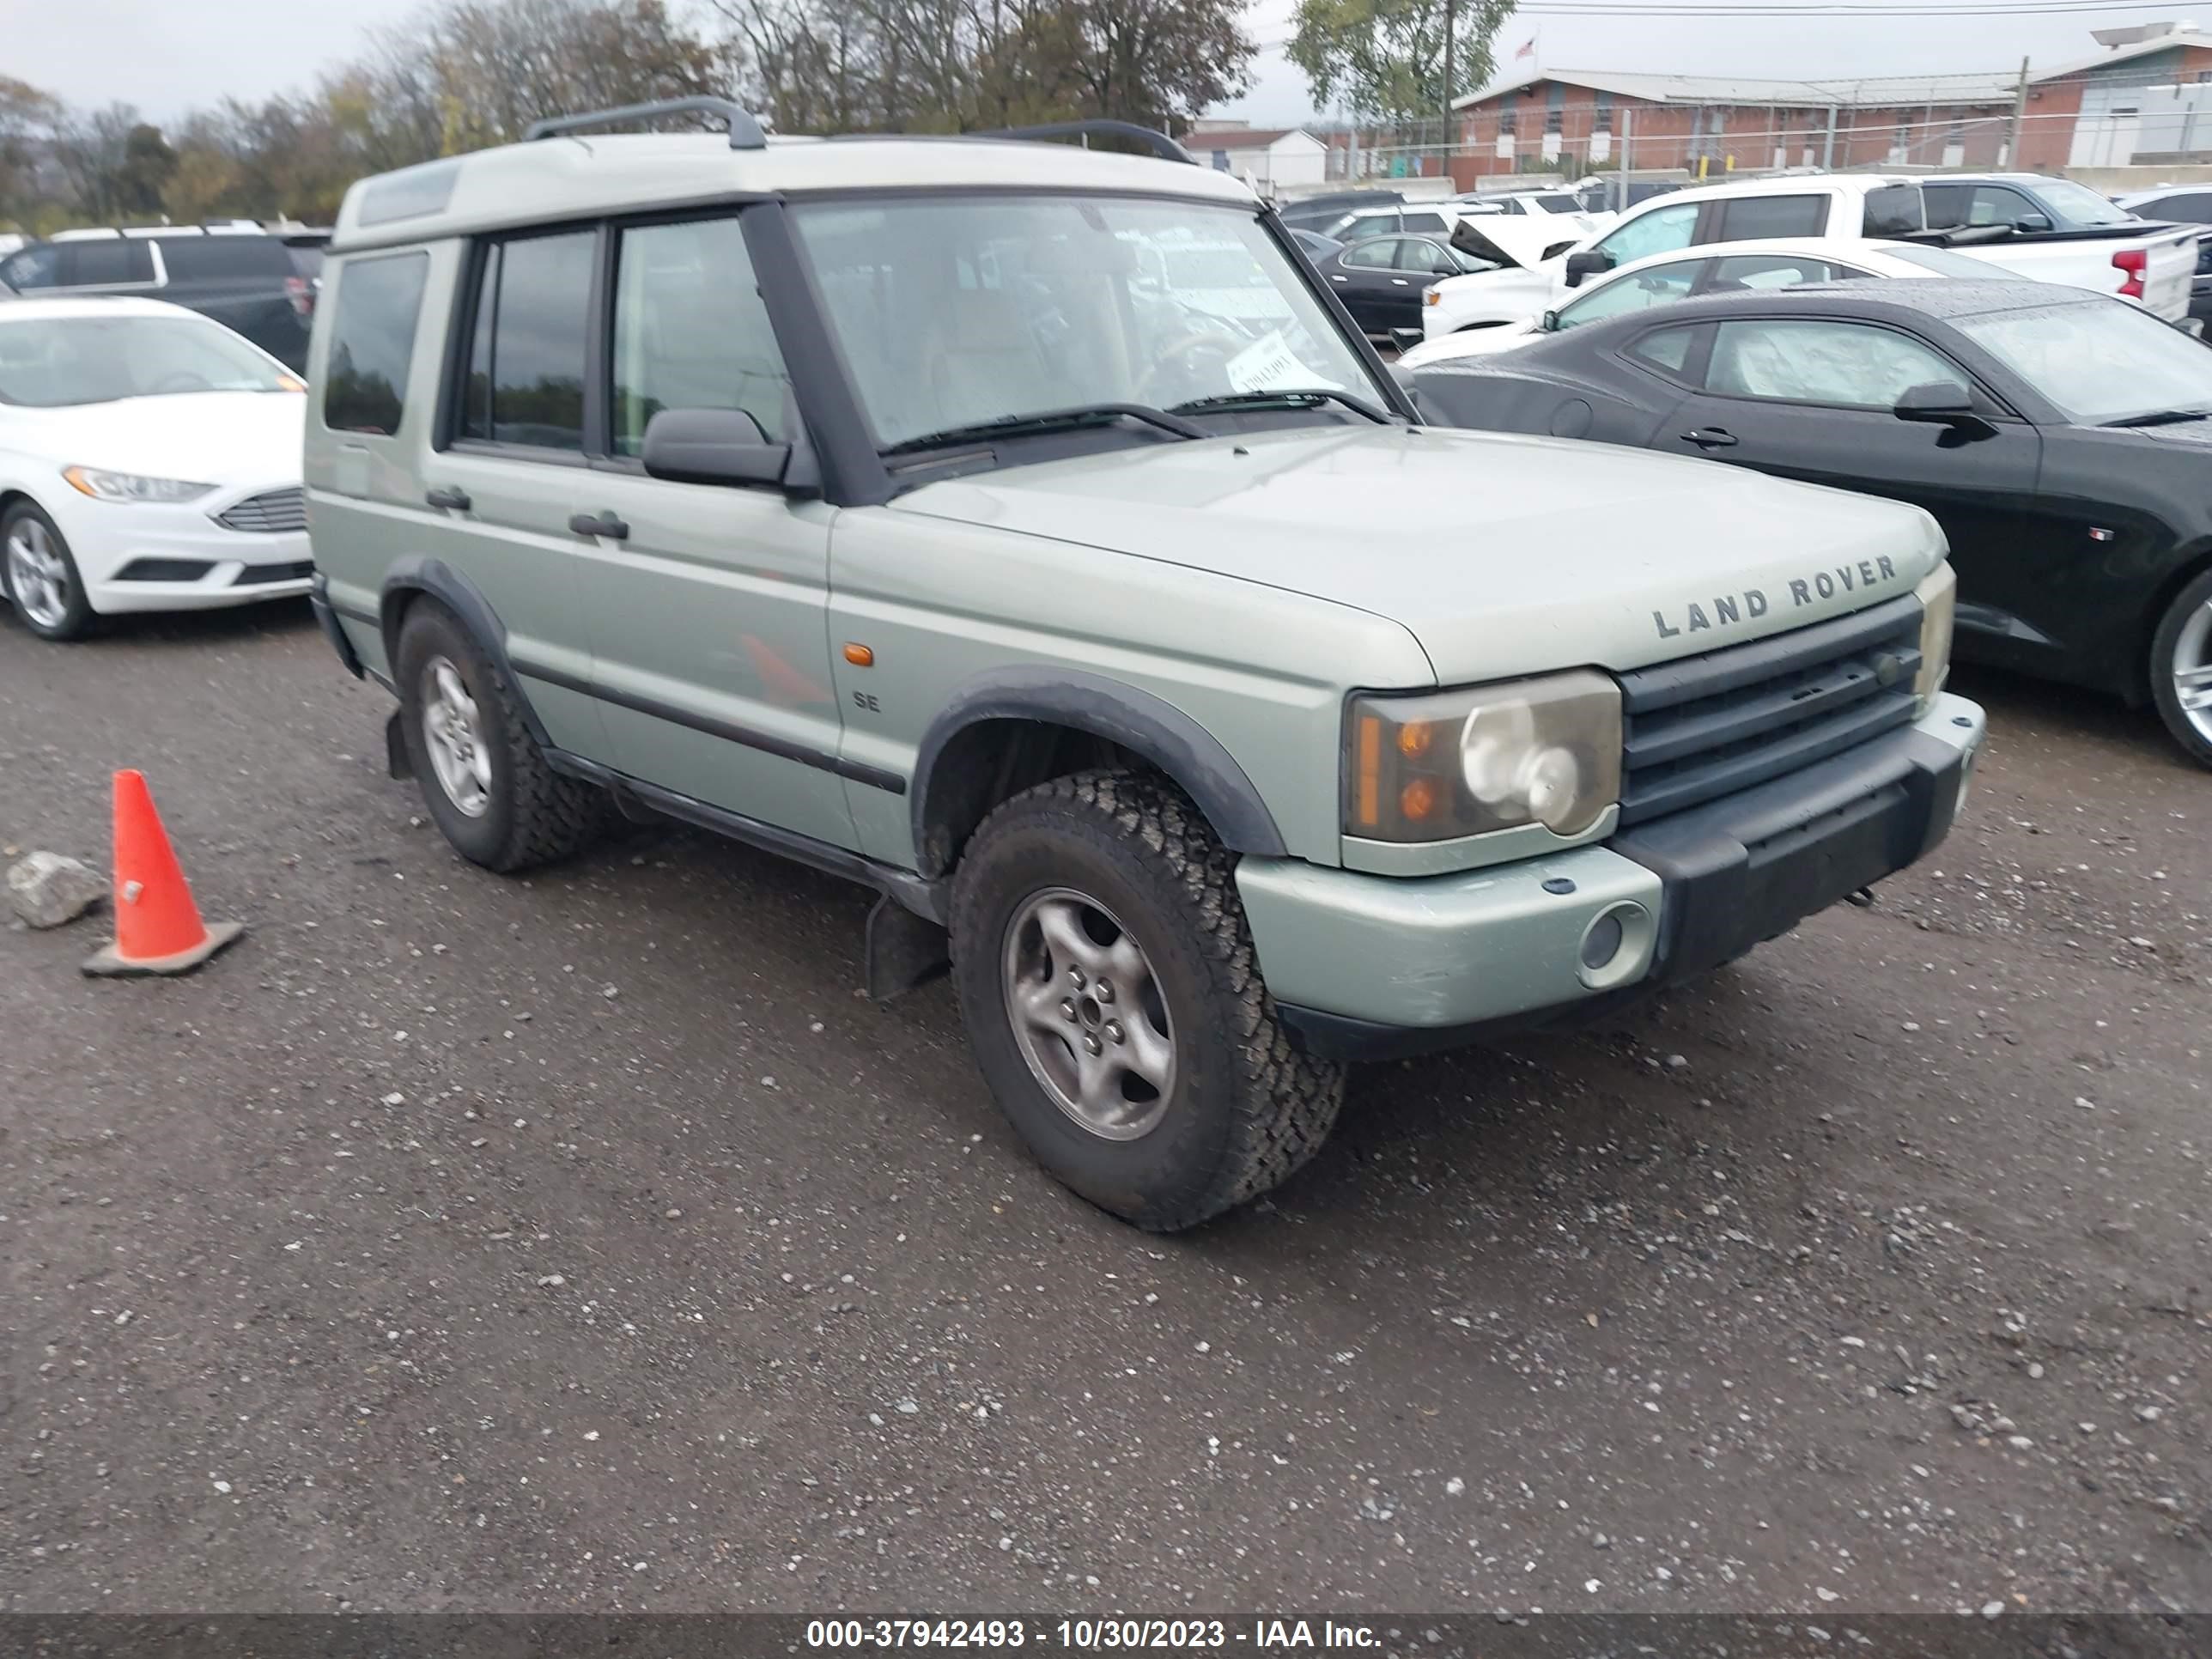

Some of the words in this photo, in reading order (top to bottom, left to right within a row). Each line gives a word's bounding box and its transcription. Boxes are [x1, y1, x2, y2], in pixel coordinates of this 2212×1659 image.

[1651, 588, 1768, 638] LAND
[1788, 555, 1897, 606] ROVER
[853, 690, 881, 714] SE
